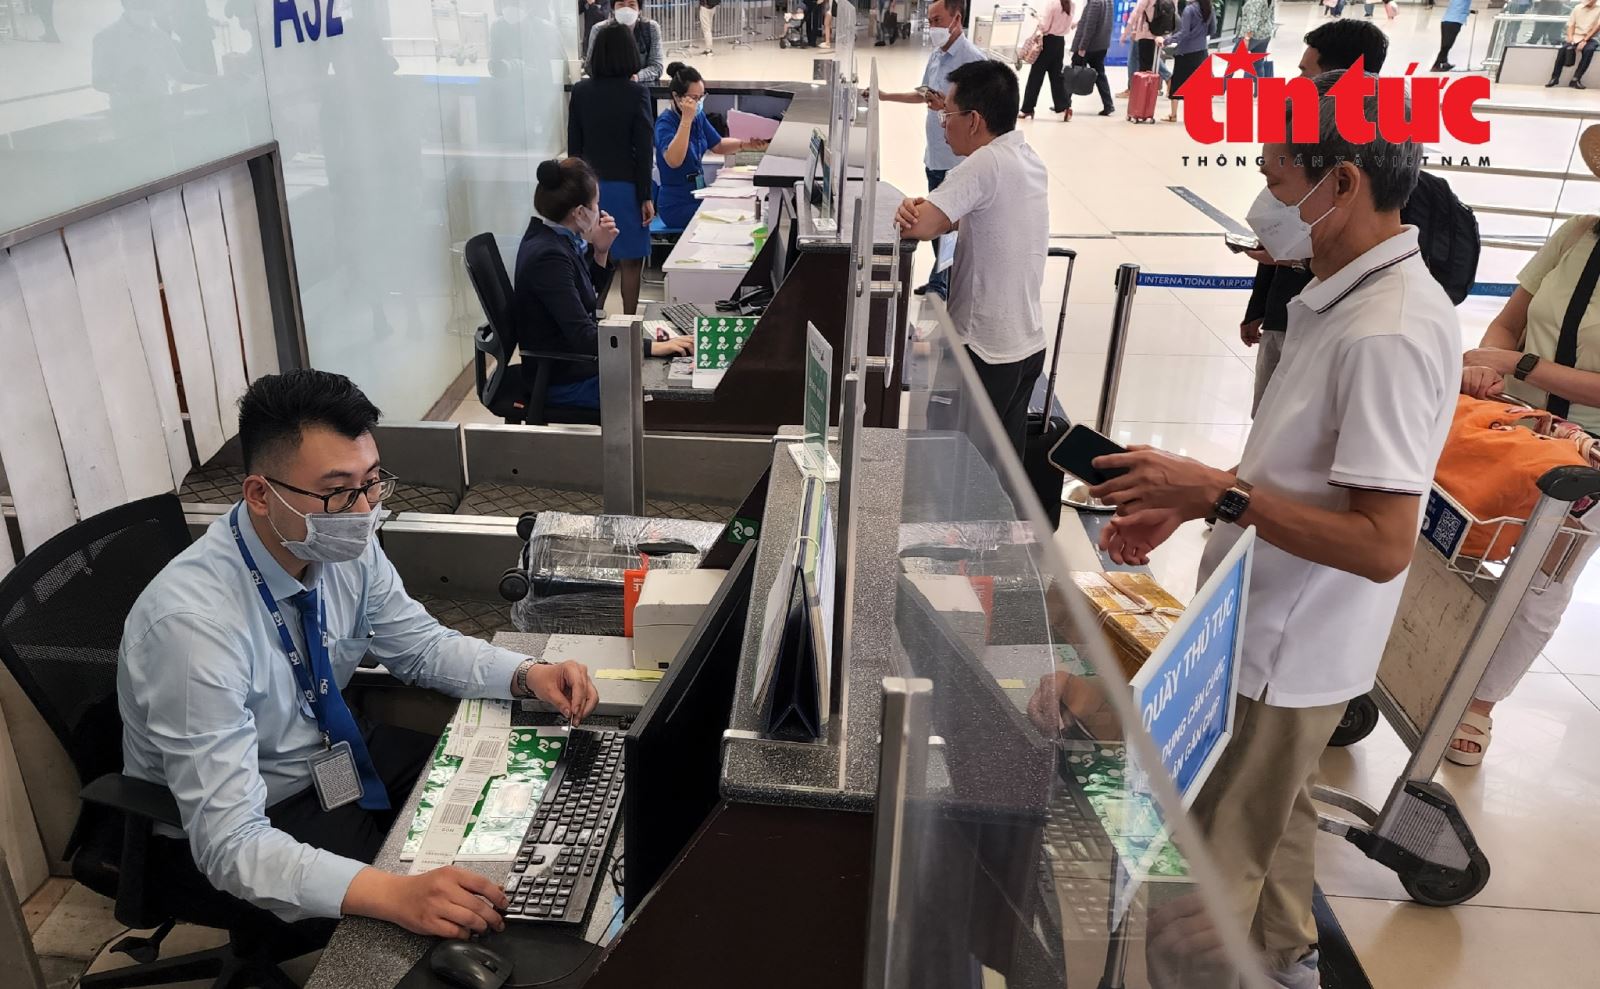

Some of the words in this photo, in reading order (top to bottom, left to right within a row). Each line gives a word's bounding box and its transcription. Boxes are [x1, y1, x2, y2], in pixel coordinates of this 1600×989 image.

[1144, 276, 1216, 286] INTERNATIONAL
[1219, 279, 1253, 287] AIRPOR
[1184, 616, 1210, 678] THỦ
[1212, 588, 1235, 638] TỤC
